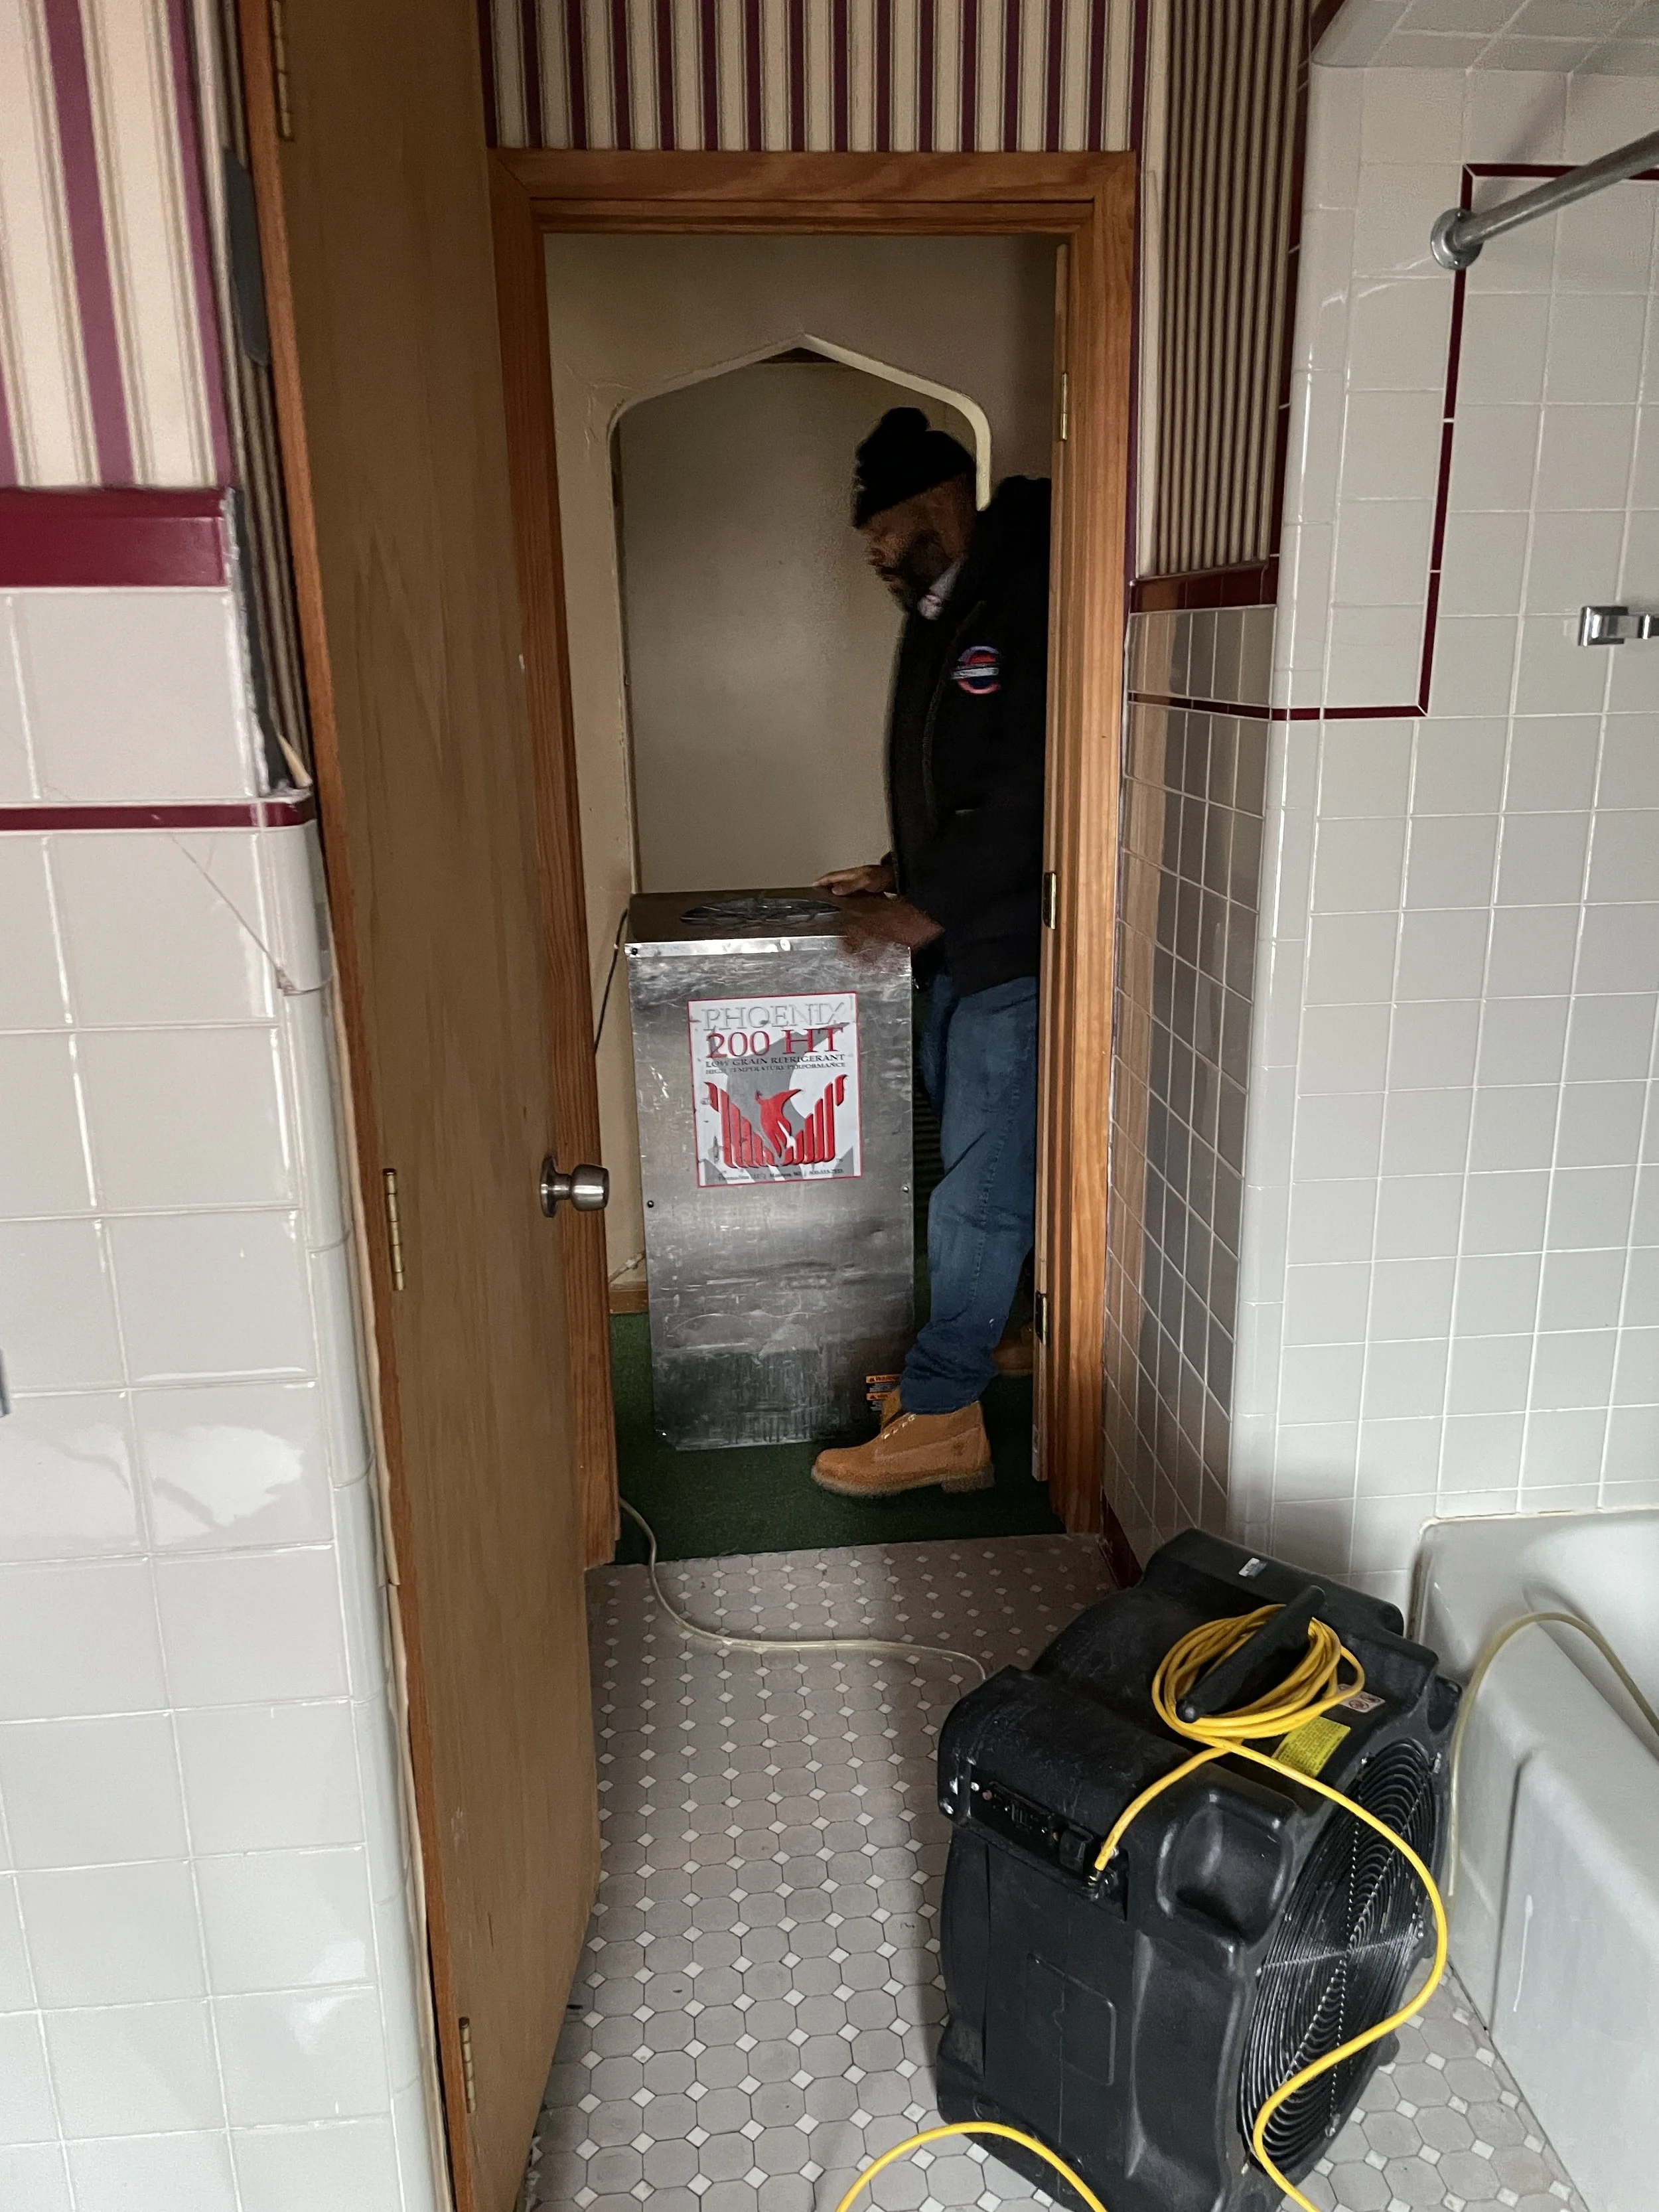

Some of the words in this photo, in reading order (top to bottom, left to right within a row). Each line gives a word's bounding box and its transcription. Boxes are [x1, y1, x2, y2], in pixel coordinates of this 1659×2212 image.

[701, 1002, 845, 1031] PHOENIX
[706, 1030, 770, 1058] 200
[781, 1027, 843, 1054] HT
[705, 1059, 729, 1068] LOW
[732, 1057, 768, 1066] GRAIN
[770, 1054, 845, 1064] REFRIGERANT
